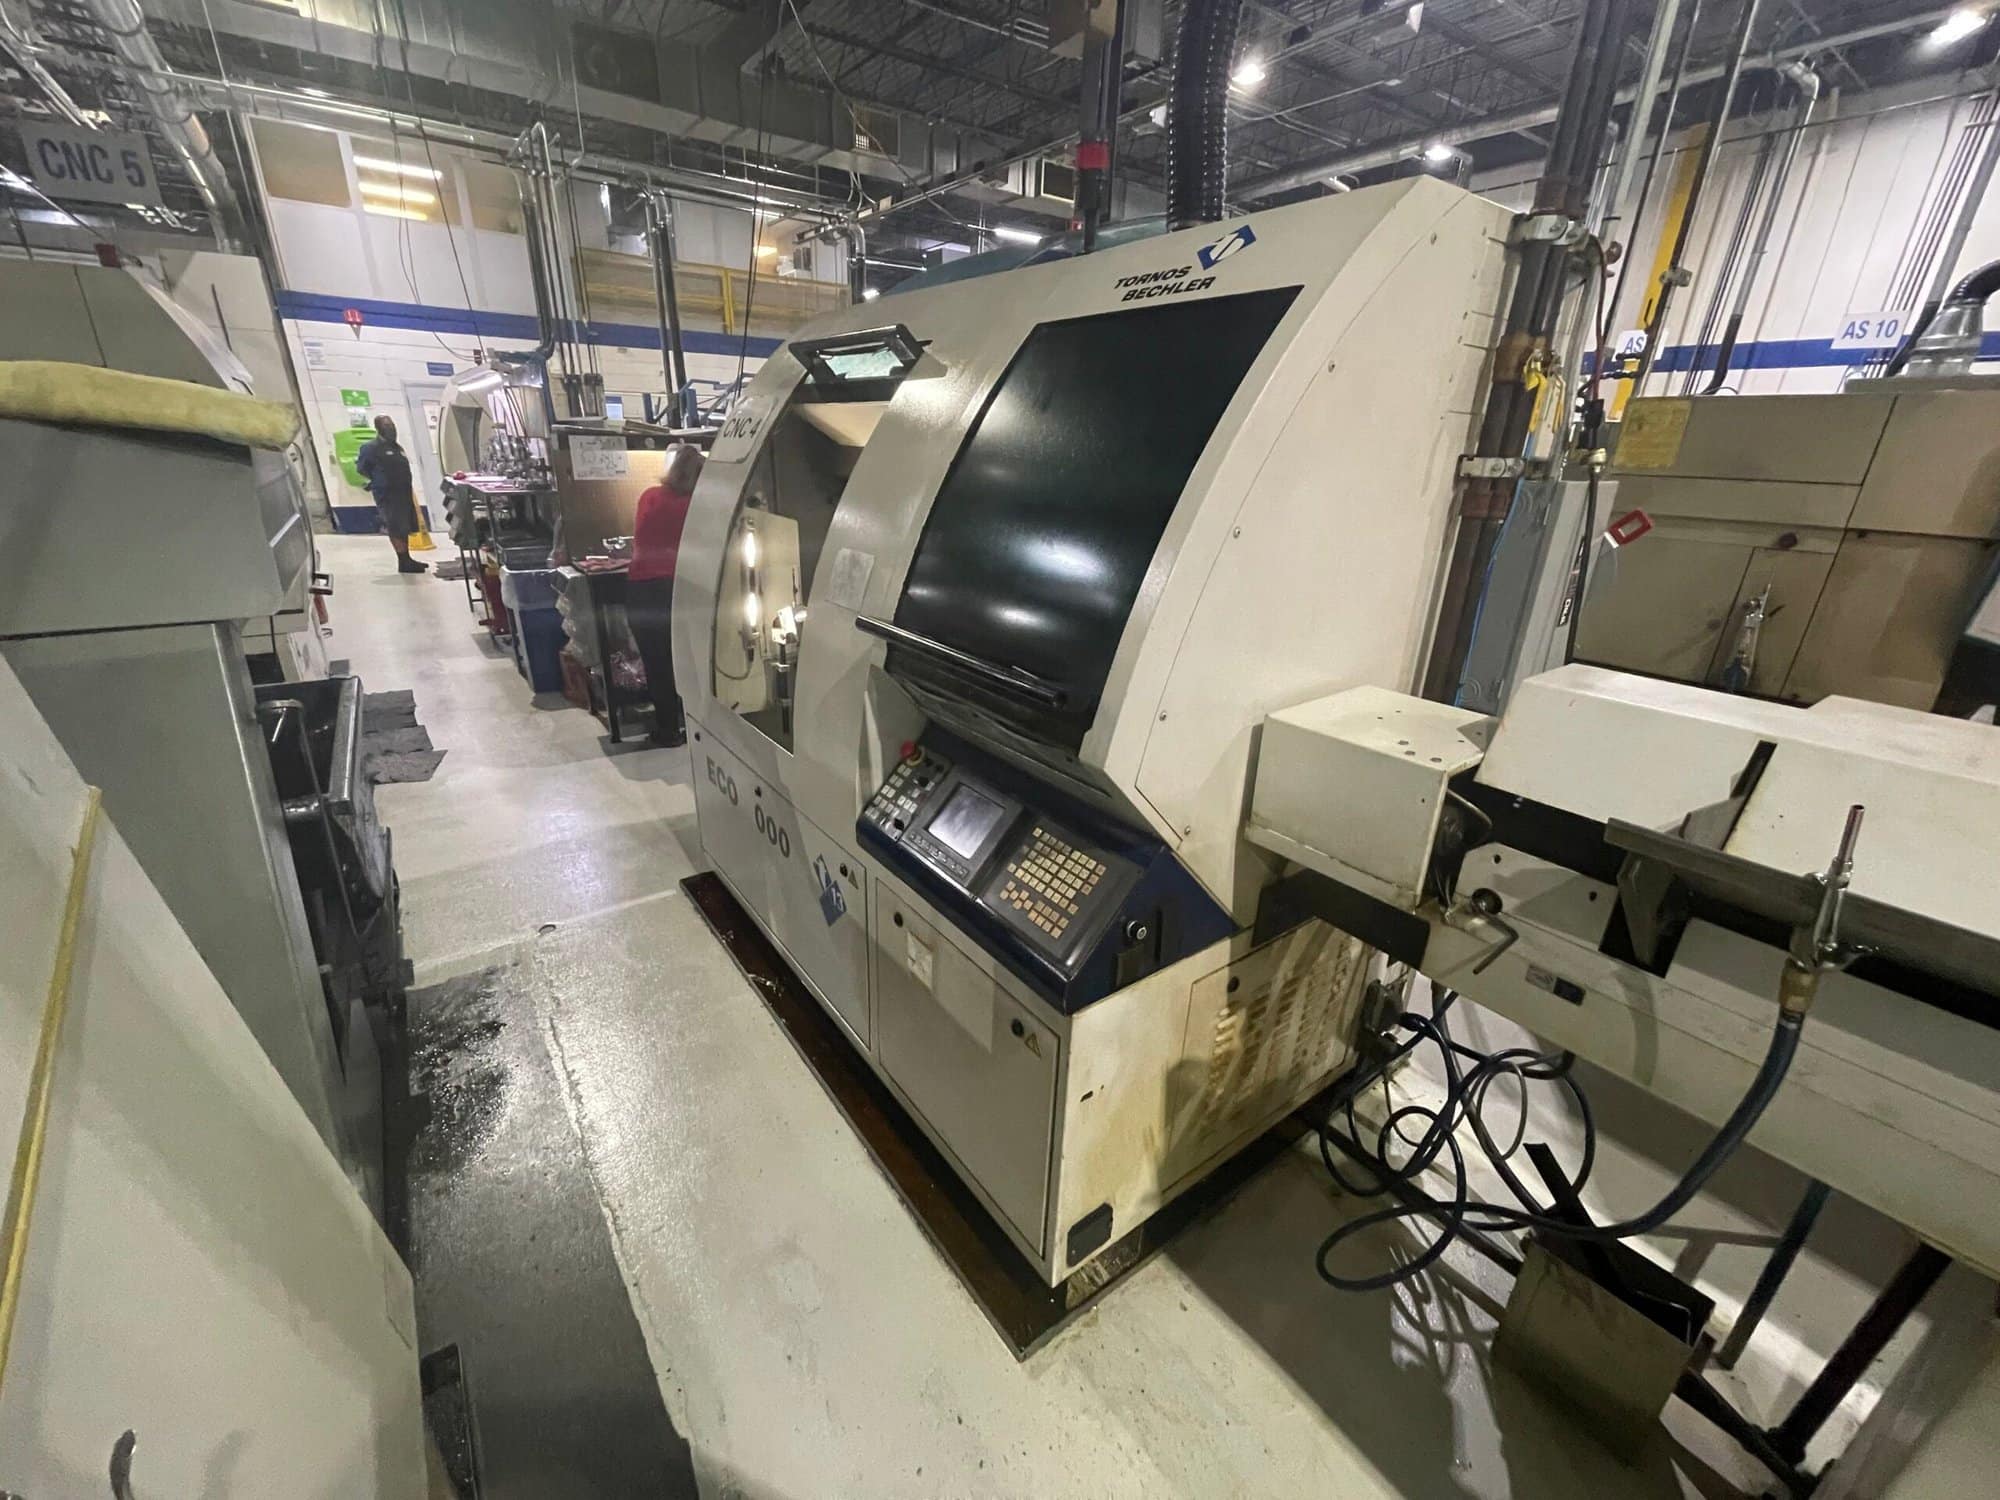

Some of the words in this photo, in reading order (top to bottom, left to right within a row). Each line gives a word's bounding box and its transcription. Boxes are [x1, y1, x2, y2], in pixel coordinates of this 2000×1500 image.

[37, 138, 115, 184] CNC
[121, 149, 147, 187] 5
[1114, 266, 1192, 289] TORNOS
[1121, 276, 1217, 302] BECHLER
[1841, 320, 1870, 340] AS
[1876, 319, 1899, 338] 10
[723, 417, 752, 438] CNC
[749, 418, 762, 438] 4
[706, 755, 739, 806] ECO
